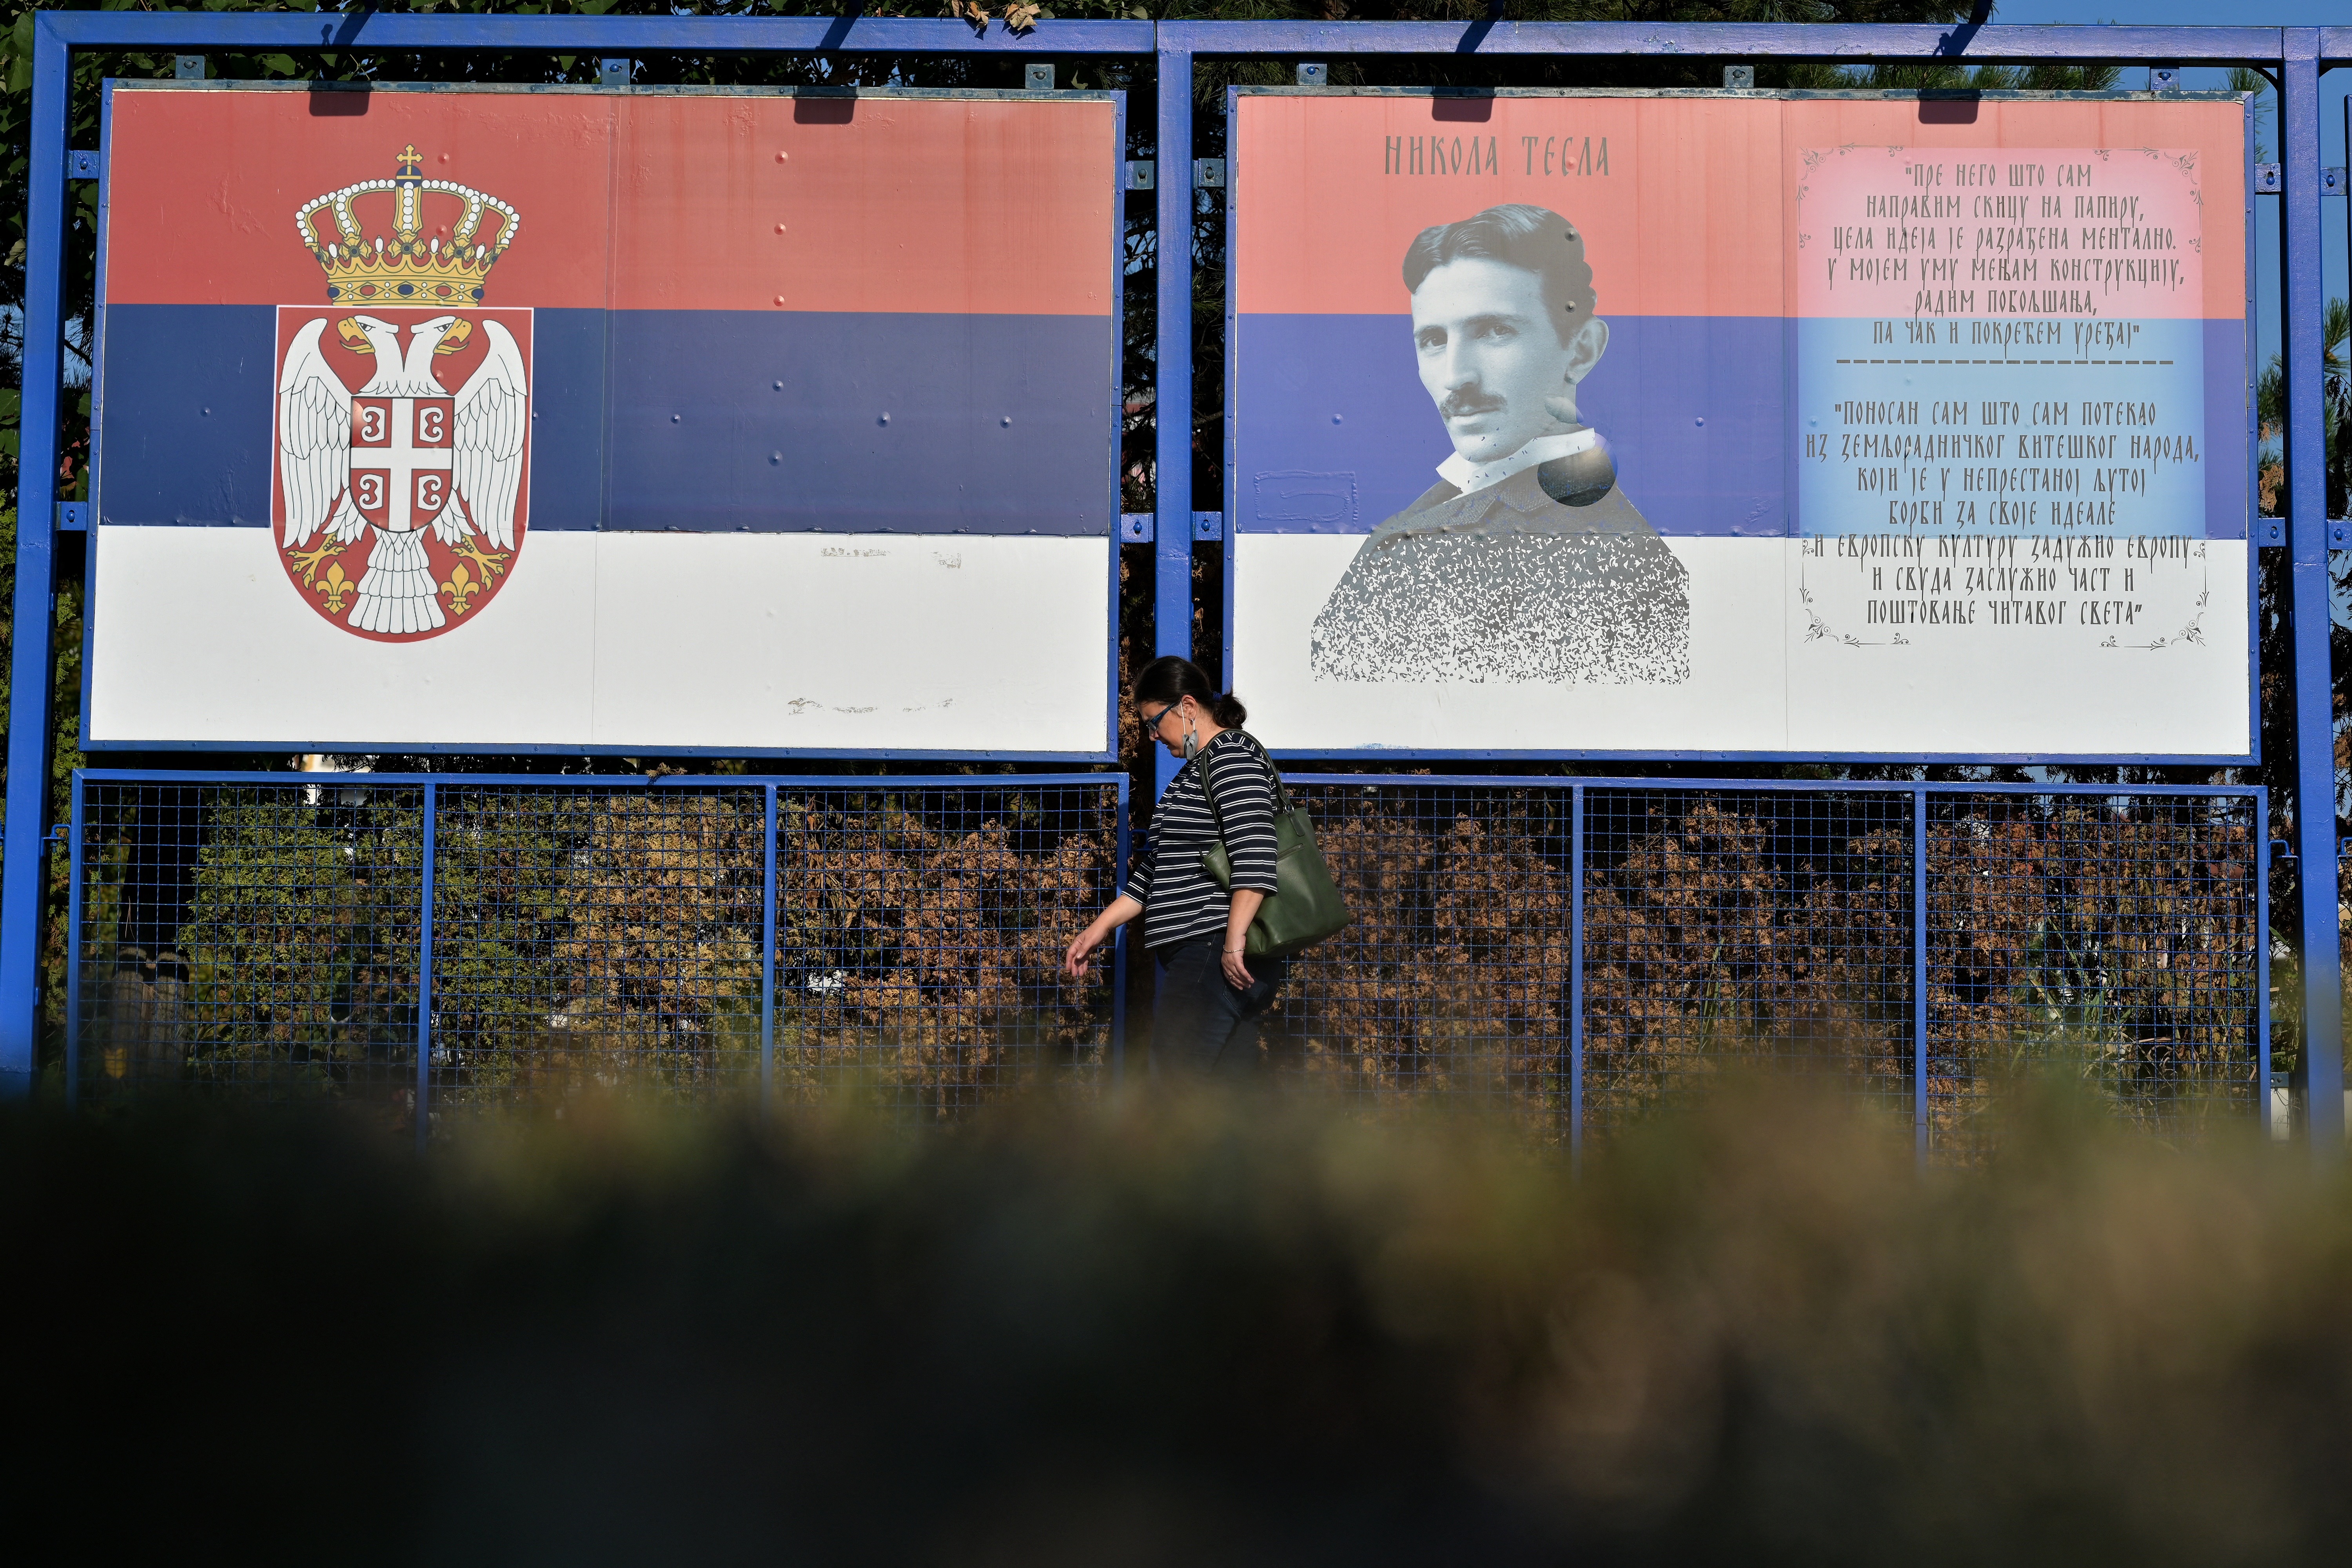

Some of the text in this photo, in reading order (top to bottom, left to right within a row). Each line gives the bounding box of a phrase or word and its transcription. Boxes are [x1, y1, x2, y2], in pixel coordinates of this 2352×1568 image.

[1385, 136, 1609, 176] НИКОЛА ТЕСЛА
[1906, 164, 2091, 201] "ПРЕ НЕГО ШТО САМ
[1867, 195, 2144, 232] НАПРАВИМ СКИЦУ НА ПАПИРУ,
[1834, 227, 2176, 263] ЦЕЛА ИДЕЈА ЈЕ РАЗРАЂЕНА МЕНТАЛНО.
[1828, 258, 2184, 296] У МОЈЕМ УМУ МЕЊАМ КОНСТРУКЦИЈУ,
[1915, 290, 1974, 326] РАДИМ
[1874, 321, 1893, 344] ПА
[1905, 321, 1936, 344] ЧАК
[1950, 321, 1958, 344] И
[1835, 401, 2156, 426] "ПОНОСАН САМ ШТО САМ ПОТЕКАО
[1806, 434, 2199, 473] ИЗ ЗЕМЉОРАДНИЧКОГ ВИТЕШКОГ НАРОДА,
[1858, 467, 2145, 506] КОЈИ ЈЕ У НЕПРЕСТАНОЈ ЉУТОЈ
[1889, 501, 2115, 535] БОРБИ ЗА СВОЈЕ ИДЕАЛЕ
[1815, 534, 2192, 573] И ЕВРОПСКУ КУЛТУРУ ЗАДУЖНО ЕВРОПУ
[1873, 567, 2133, 601] И СВУДА ЗАСЛУЖНО ЧАСТ И
[1867, 600, 1975, 624] ПОШТОВАЊЕ
[1988, 601, 2066, 625] ЧИТАВОГ
